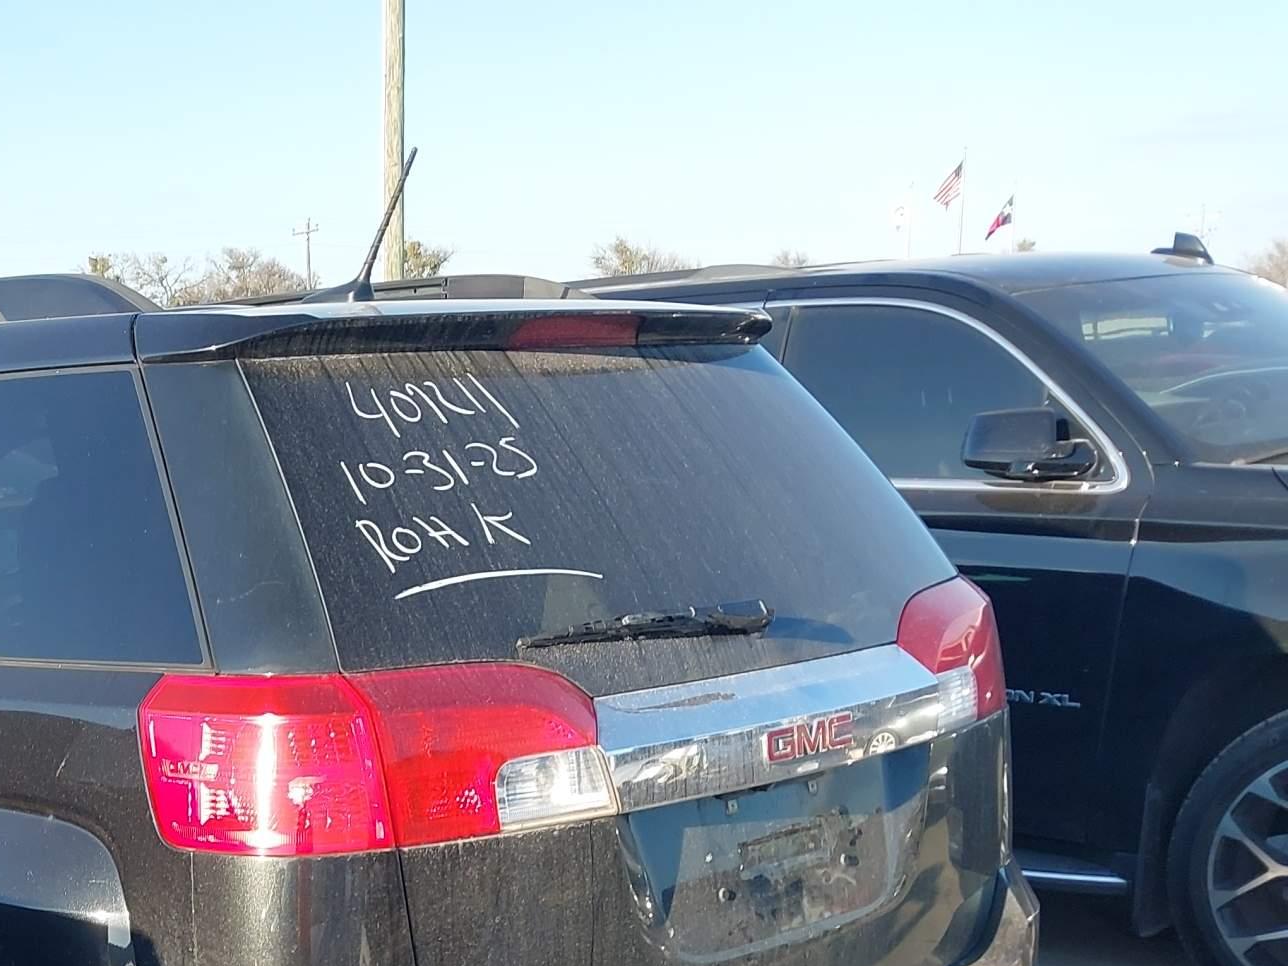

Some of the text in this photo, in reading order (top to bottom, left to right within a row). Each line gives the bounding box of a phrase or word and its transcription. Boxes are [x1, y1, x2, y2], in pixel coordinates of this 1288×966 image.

[340, 437, 538, 505] 10-31-25
[1038, 691, 1082, 708] XL
[767, 711, 854, 763] GMC
